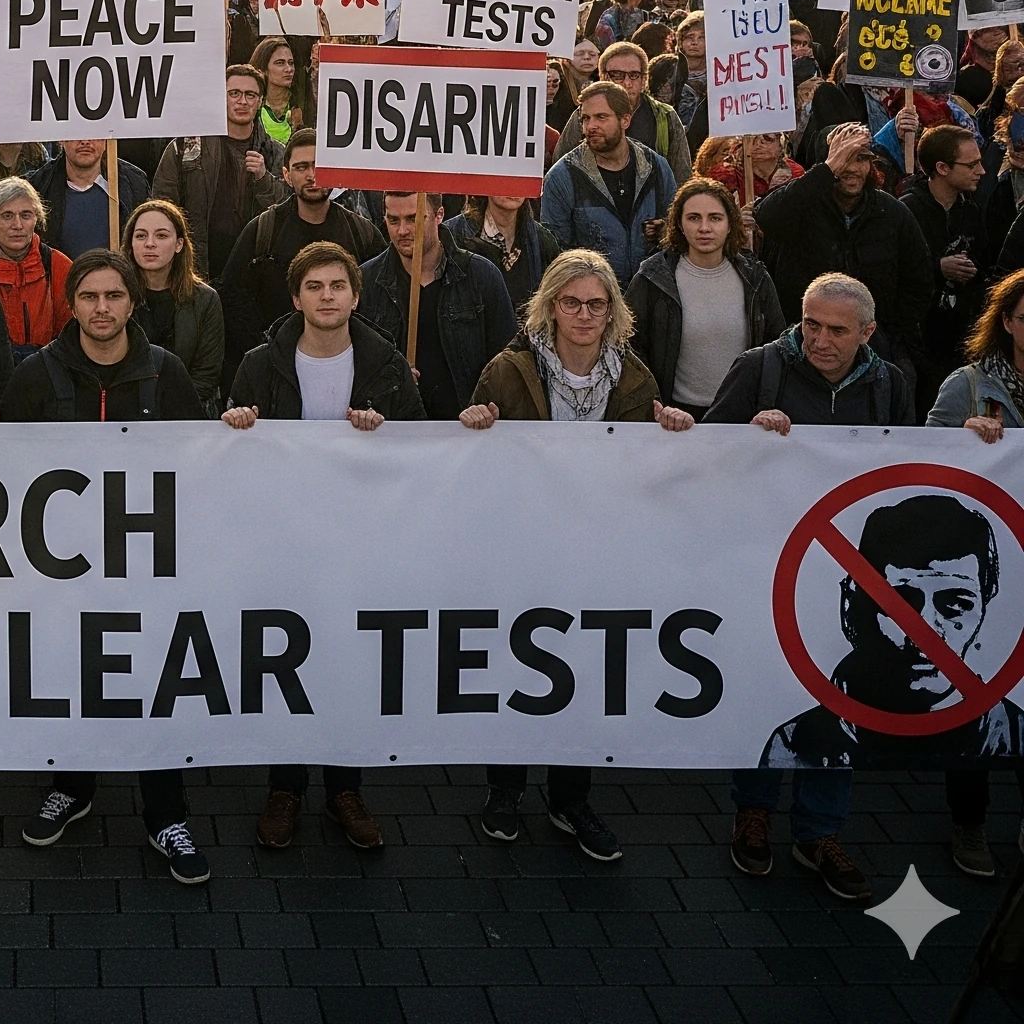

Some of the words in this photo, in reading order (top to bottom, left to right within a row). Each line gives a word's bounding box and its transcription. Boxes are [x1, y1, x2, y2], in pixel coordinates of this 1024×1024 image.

[31, 55, 174, 121] NOW
[327, 79, 536, 158] DISARM!
[357, 608, 723, 718] TESTS
